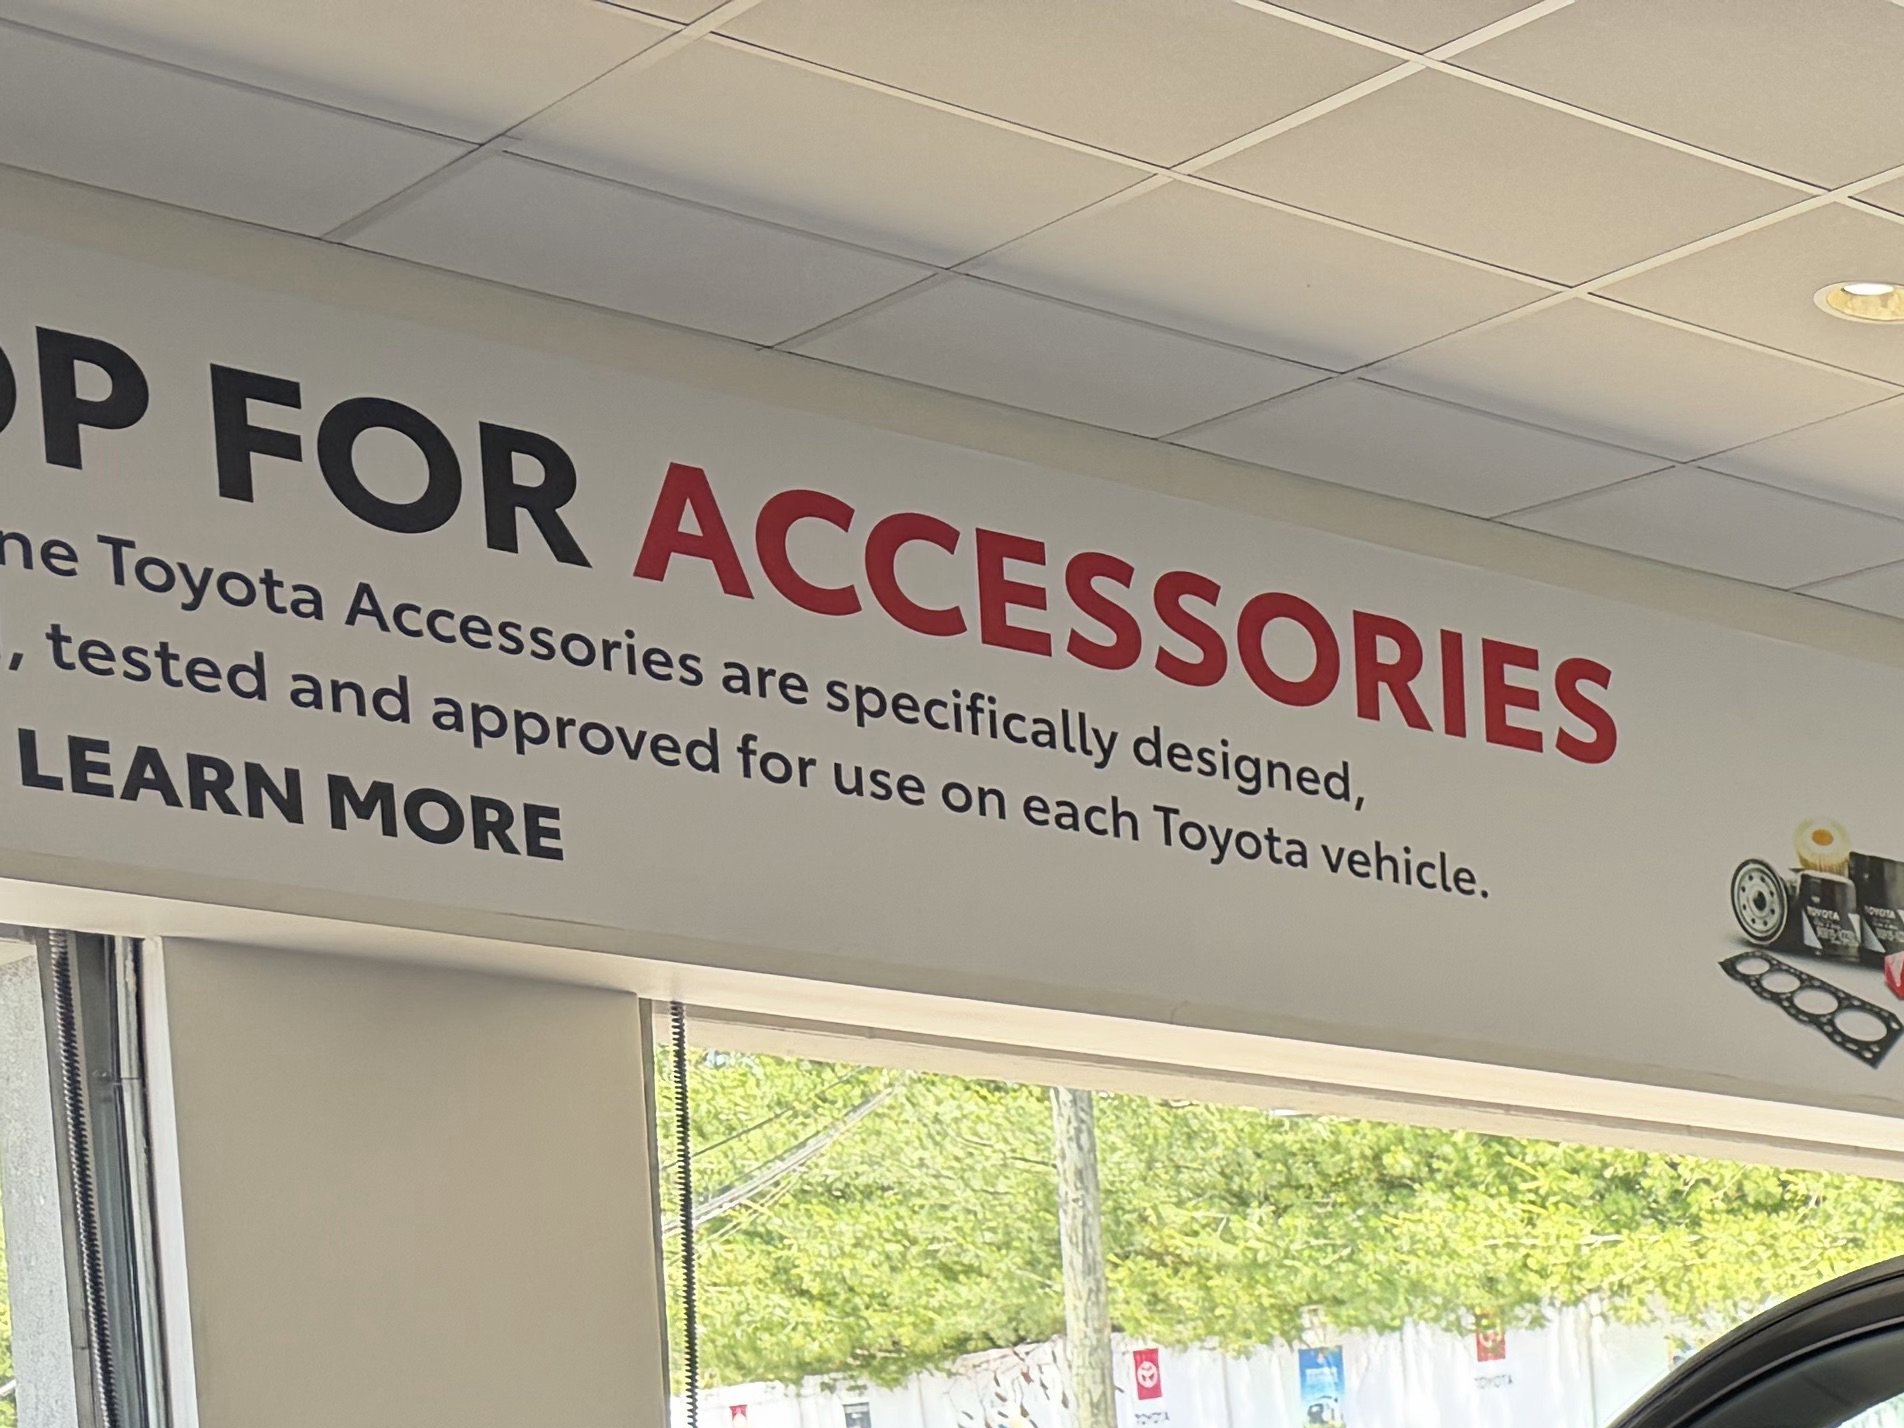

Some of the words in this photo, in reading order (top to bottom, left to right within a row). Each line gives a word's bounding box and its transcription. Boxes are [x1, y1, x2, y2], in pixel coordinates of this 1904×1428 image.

[0, 326, 149, 470] P
[210, 363, 592, 568] FOR
[633, 462, 1617, 764] ACCESSORIES
[97, 534, 323, 620] Toyota
[345, 582, 703, 686] Accessories
[722, 662, 808, 704] are
[826, 681, 1118, 769] specifically
[1133, 726, 1364, 811] designed,
[18, 728, 304, 824] LEARN
[327, 774, 563, 860] MORE
[46, 624, 266, 701] tested
[290, 674, 410, 724] and
[432, 698, 719, 773] approved
[737, 734, 816, 787] for
[834, 763, 925, 806] use
[942, 782, 1005, 819] on
[1023, 796, 1139, 841] each
[1153, 805, 1307, 868] Toyota
[1321, 841, 1490, 898] vehicle.
